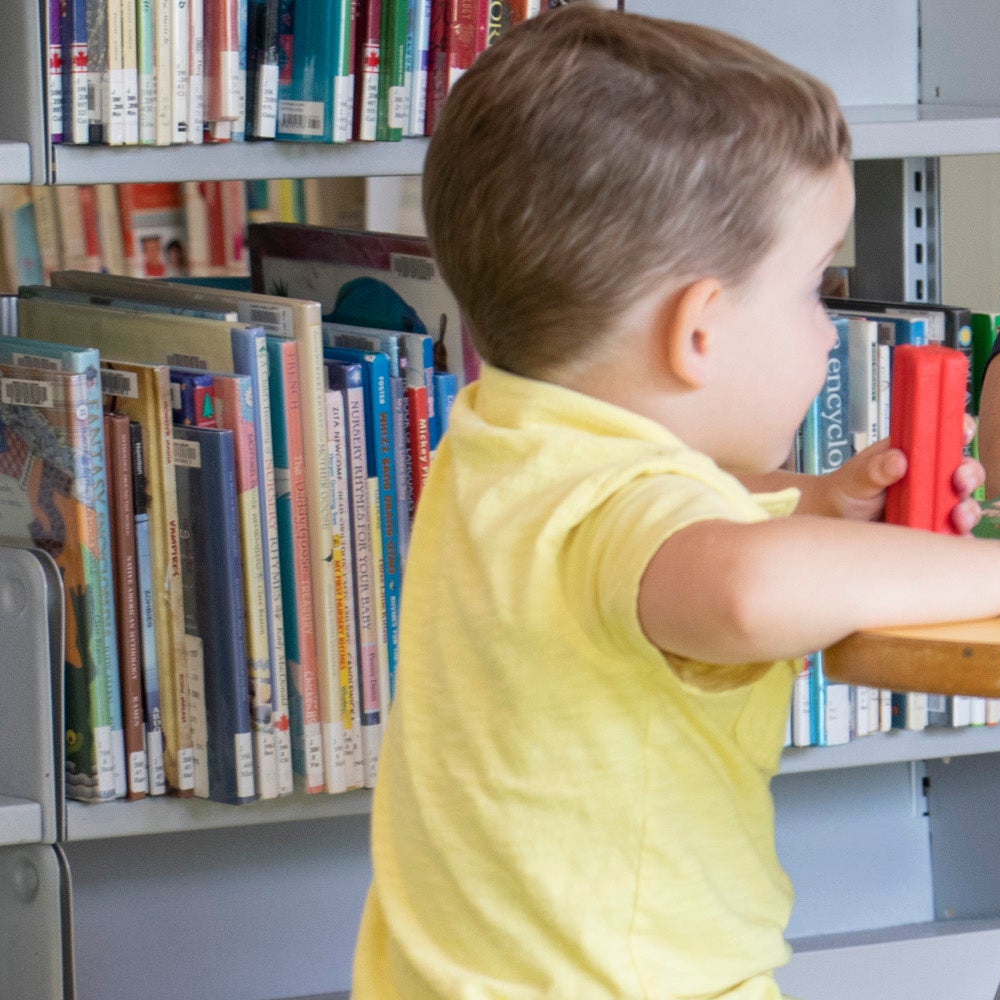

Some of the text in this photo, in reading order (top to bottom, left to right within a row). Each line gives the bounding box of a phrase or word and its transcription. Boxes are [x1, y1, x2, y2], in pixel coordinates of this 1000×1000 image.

[288, 352, 299, 409] FRENCH
[332, 406, 340, 428] ZITA
[351, 400, 362, 461] NURSERY
[380, 412, 389, 454] WHIZZ
[419, 418, 428, 463] Mickey
[353, 465, 366, 521] RHYMES
[382, 458, 391, 490] BANG
[293, 480, 307, 525] Daddy
[169, 520, 179, 577] VAMPIRES
[264, 458, 276, 530] NURSERY
[270, 536, 282, 602] RHYMES
[296, 527, 310, 574] Goose
[357, 524, 368, 552] FOR
[359, 555, 369, 592] YOUR
[128, 586, 136, 629] AMERICAN
[361, 597, 371, 630] BABY
[129, 630, 138, 680] MYTHOLOGY
[368, 653, 376, 677] Penny
[132, 696, 140, 727] RAMEN
